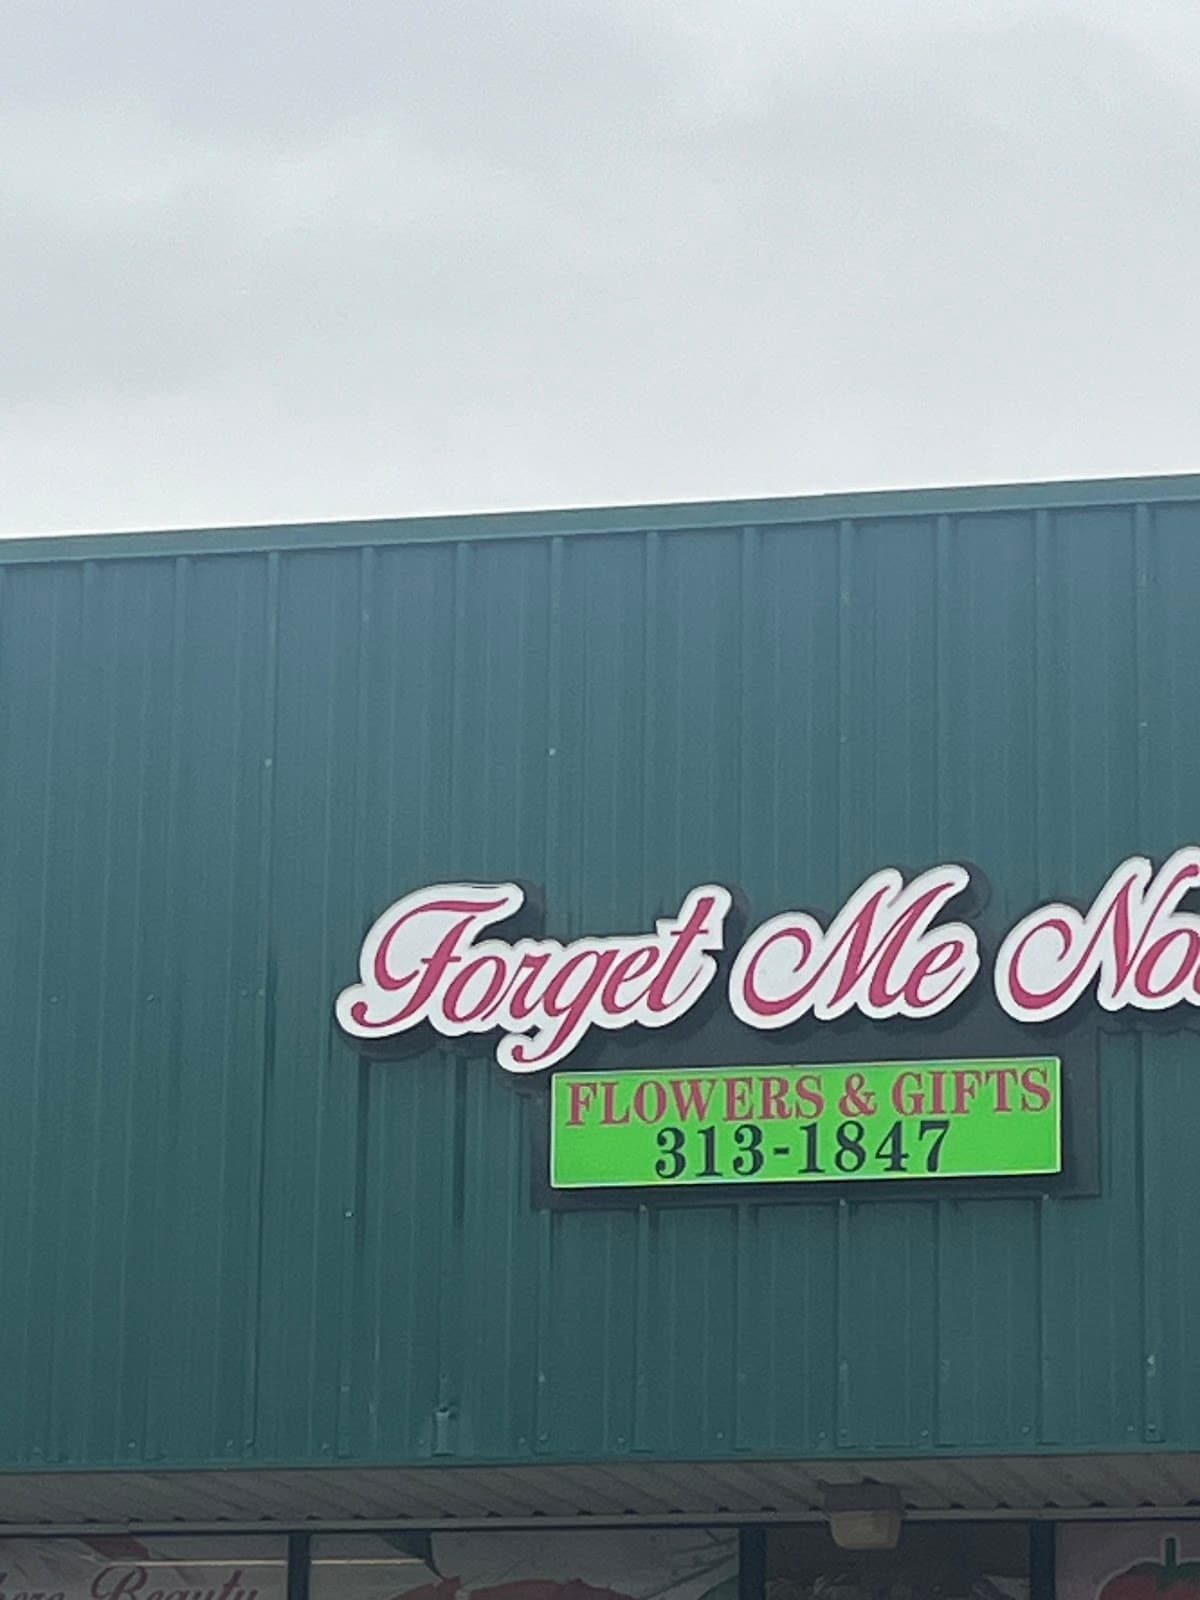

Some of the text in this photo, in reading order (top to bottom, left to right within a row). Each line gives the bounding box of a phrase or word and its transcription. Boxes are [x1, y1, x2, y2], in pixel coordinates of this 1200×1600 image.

[352, 863, 1200, 1064] Forget Me No
[564, 1066, 1052, 1126] FLOWERS & GIFTS
[655, 1119, 951, 1178] 313-1847
